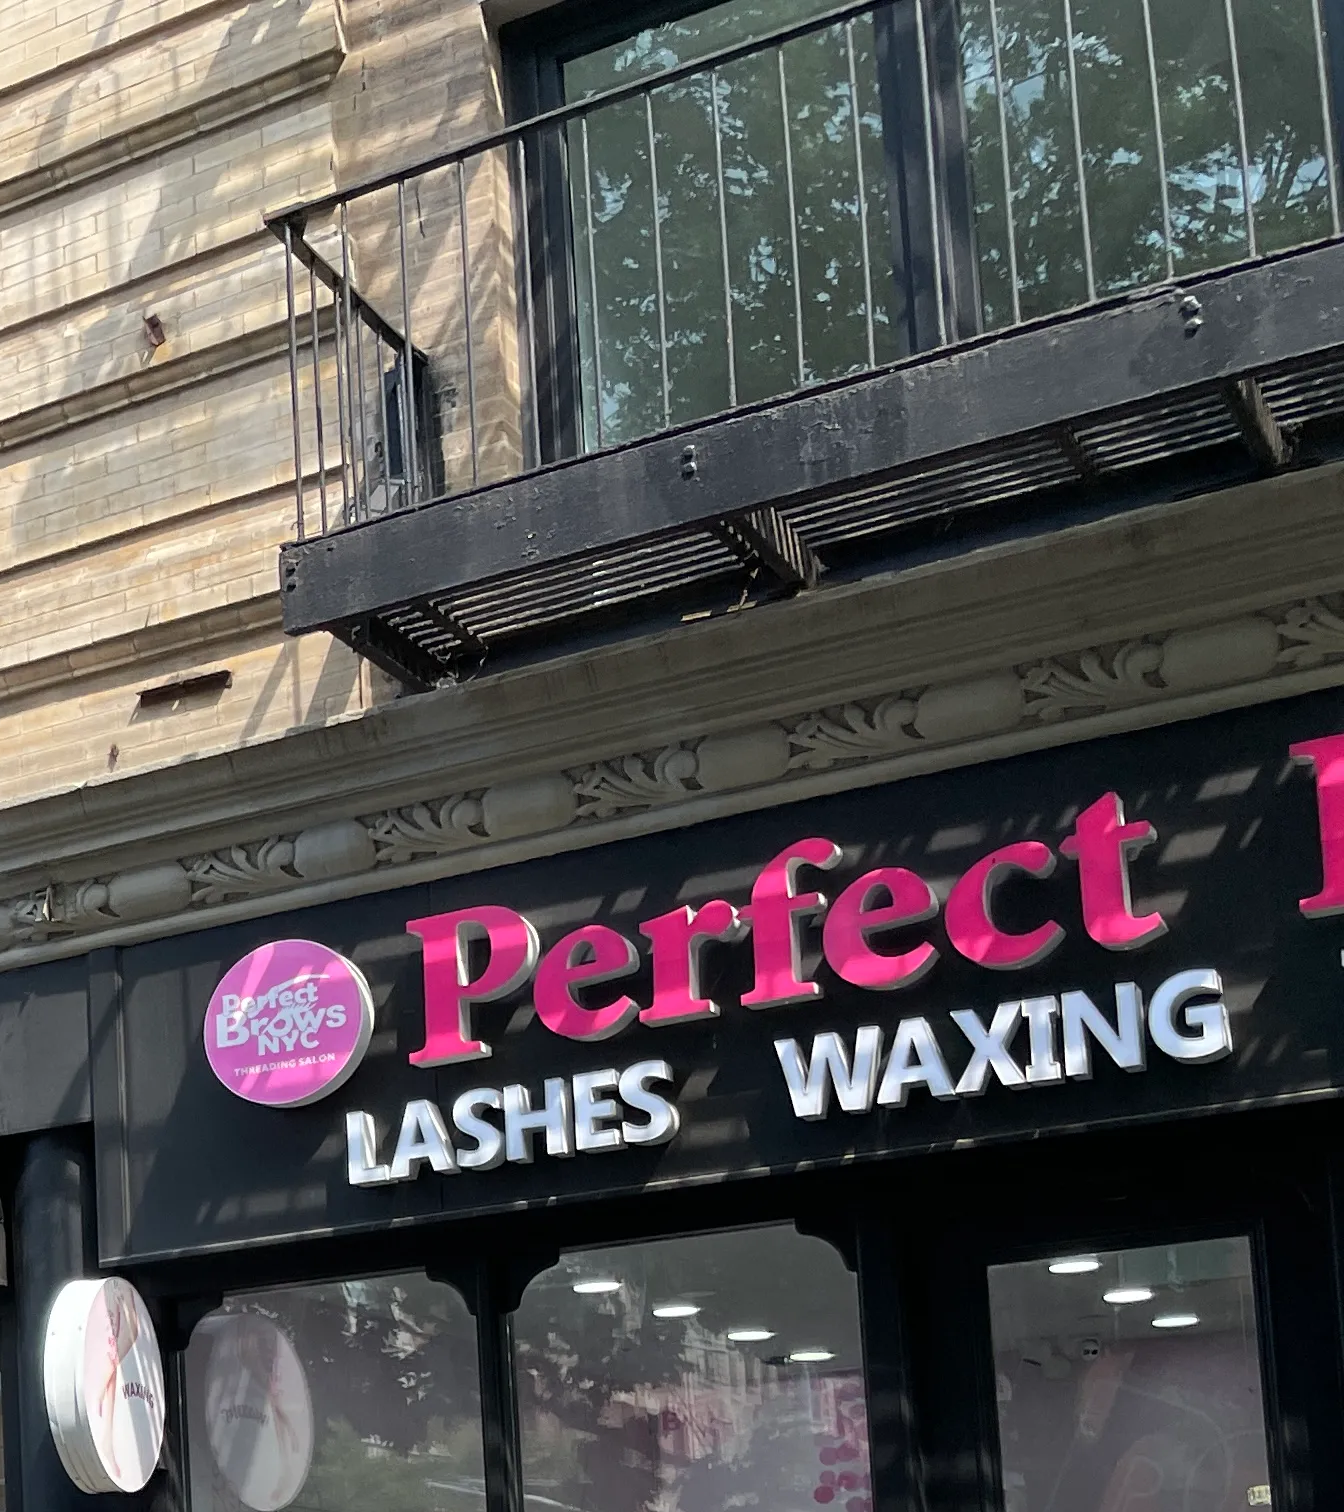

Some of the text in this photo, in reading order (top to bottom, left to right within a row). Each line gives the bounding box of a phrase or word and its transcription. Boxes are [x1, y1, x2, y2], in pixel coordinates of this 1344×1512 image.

[407, 791, 1169, 1068] Perfect
[222, 982, 319, 1018] Perfect
[257, 1027, 320, 1056] NYC
[234, 1053, 336, 1077] THREADING SALON
[345, 968, 1233, 1188] LASHES WAXING
[122, 1381, 154, 1409] WAXING
